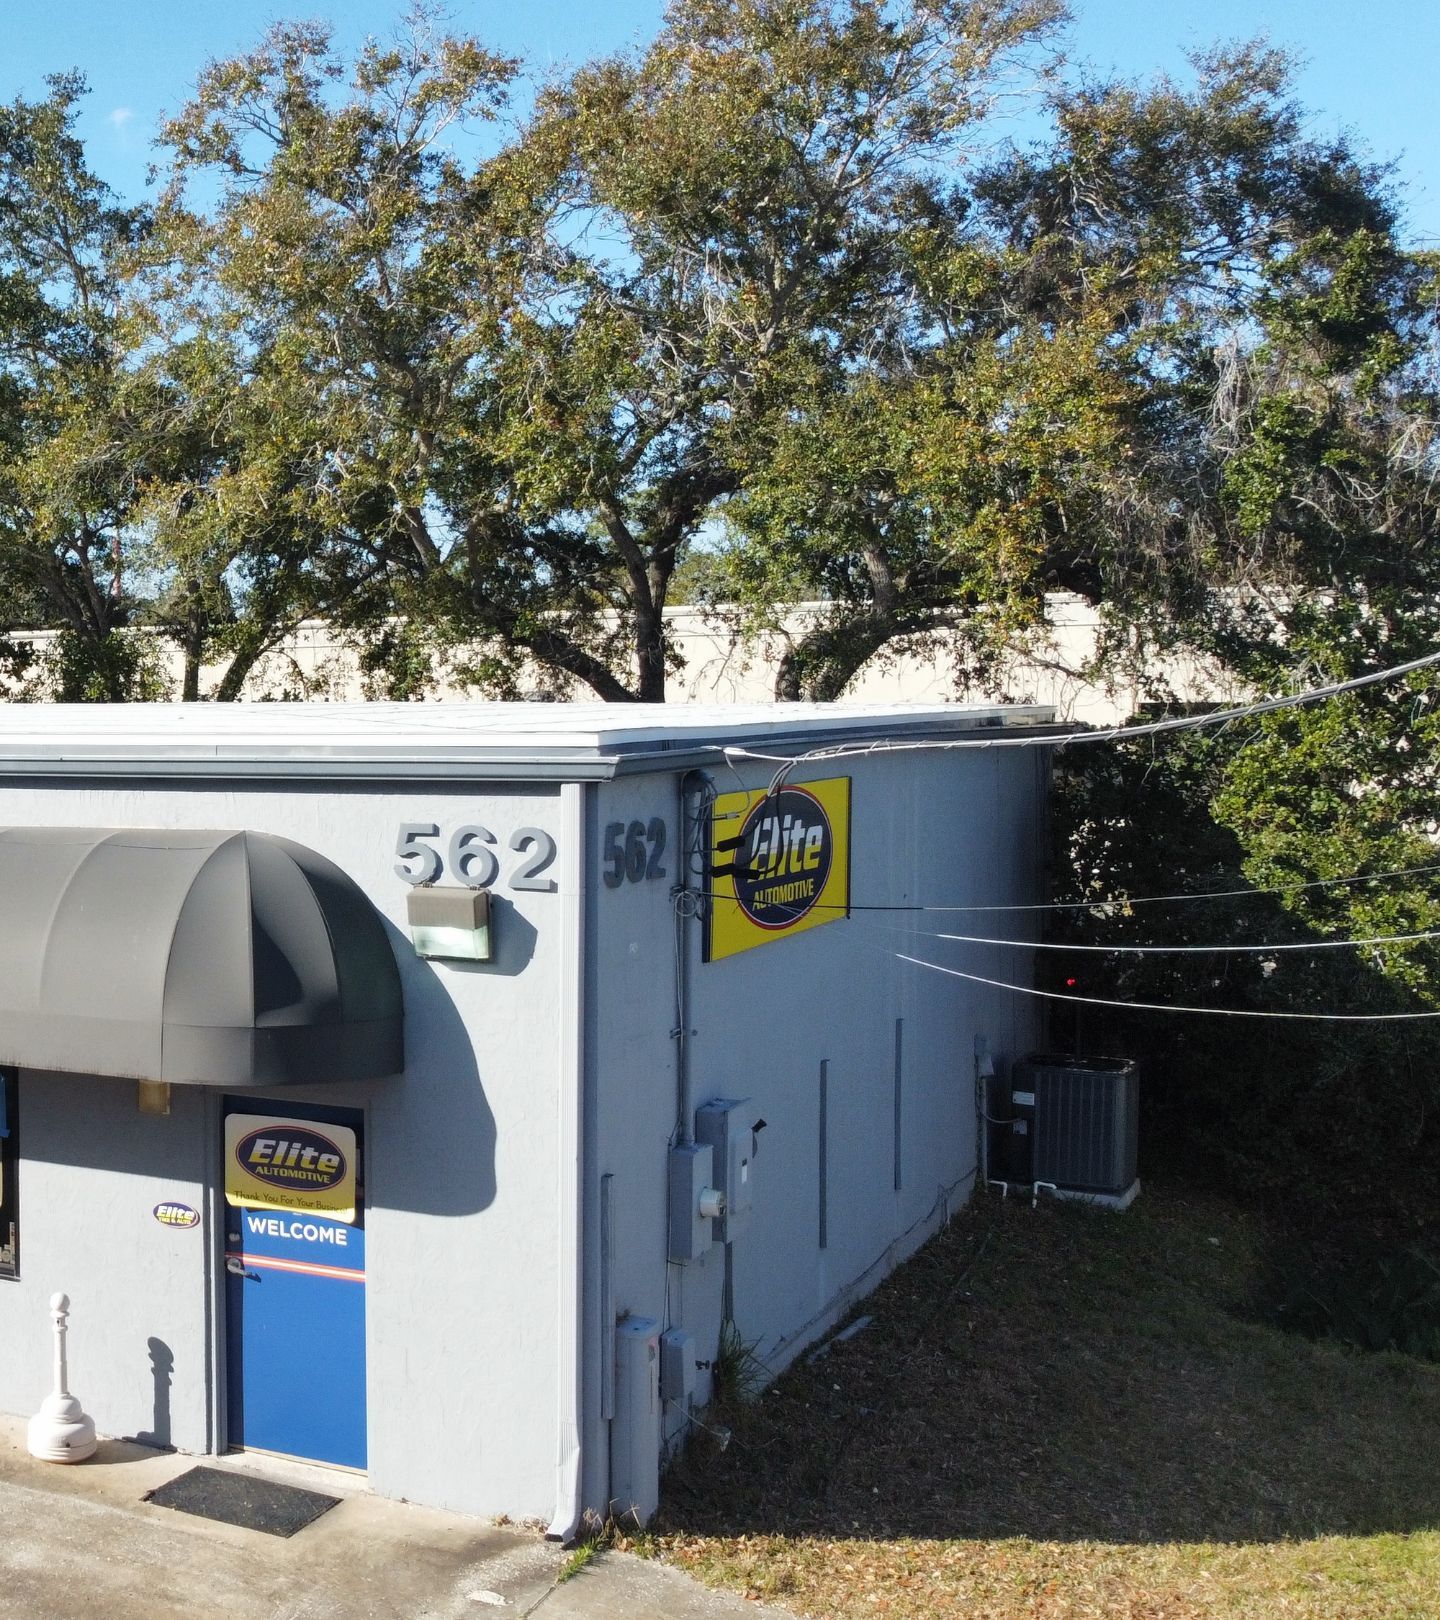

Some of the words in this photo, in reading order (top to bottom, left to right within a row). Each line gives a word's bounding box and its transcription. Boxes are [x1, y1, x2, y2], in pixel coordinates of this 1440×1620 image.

[394, 823, 555, 893] 562
[603, 817, 666, 889] 562
[747, 814, 823, 883] Elite
[752, 878, 814, 912] AUTOMOTIVE
[248, 1138, 340, 1173] Elite
[255, 1166, 330, 1183] AUTOMOTIVE
[157, 1205, 194, 1221] Elite
[234, 1191, 260, 1201] Thank
[263, 1192, 278, 1202] You
[280, 1195, 294, 1205] For
[296, 1198, 314, 1208] Your
[247, 1216, 347, 1246] WELCOME
